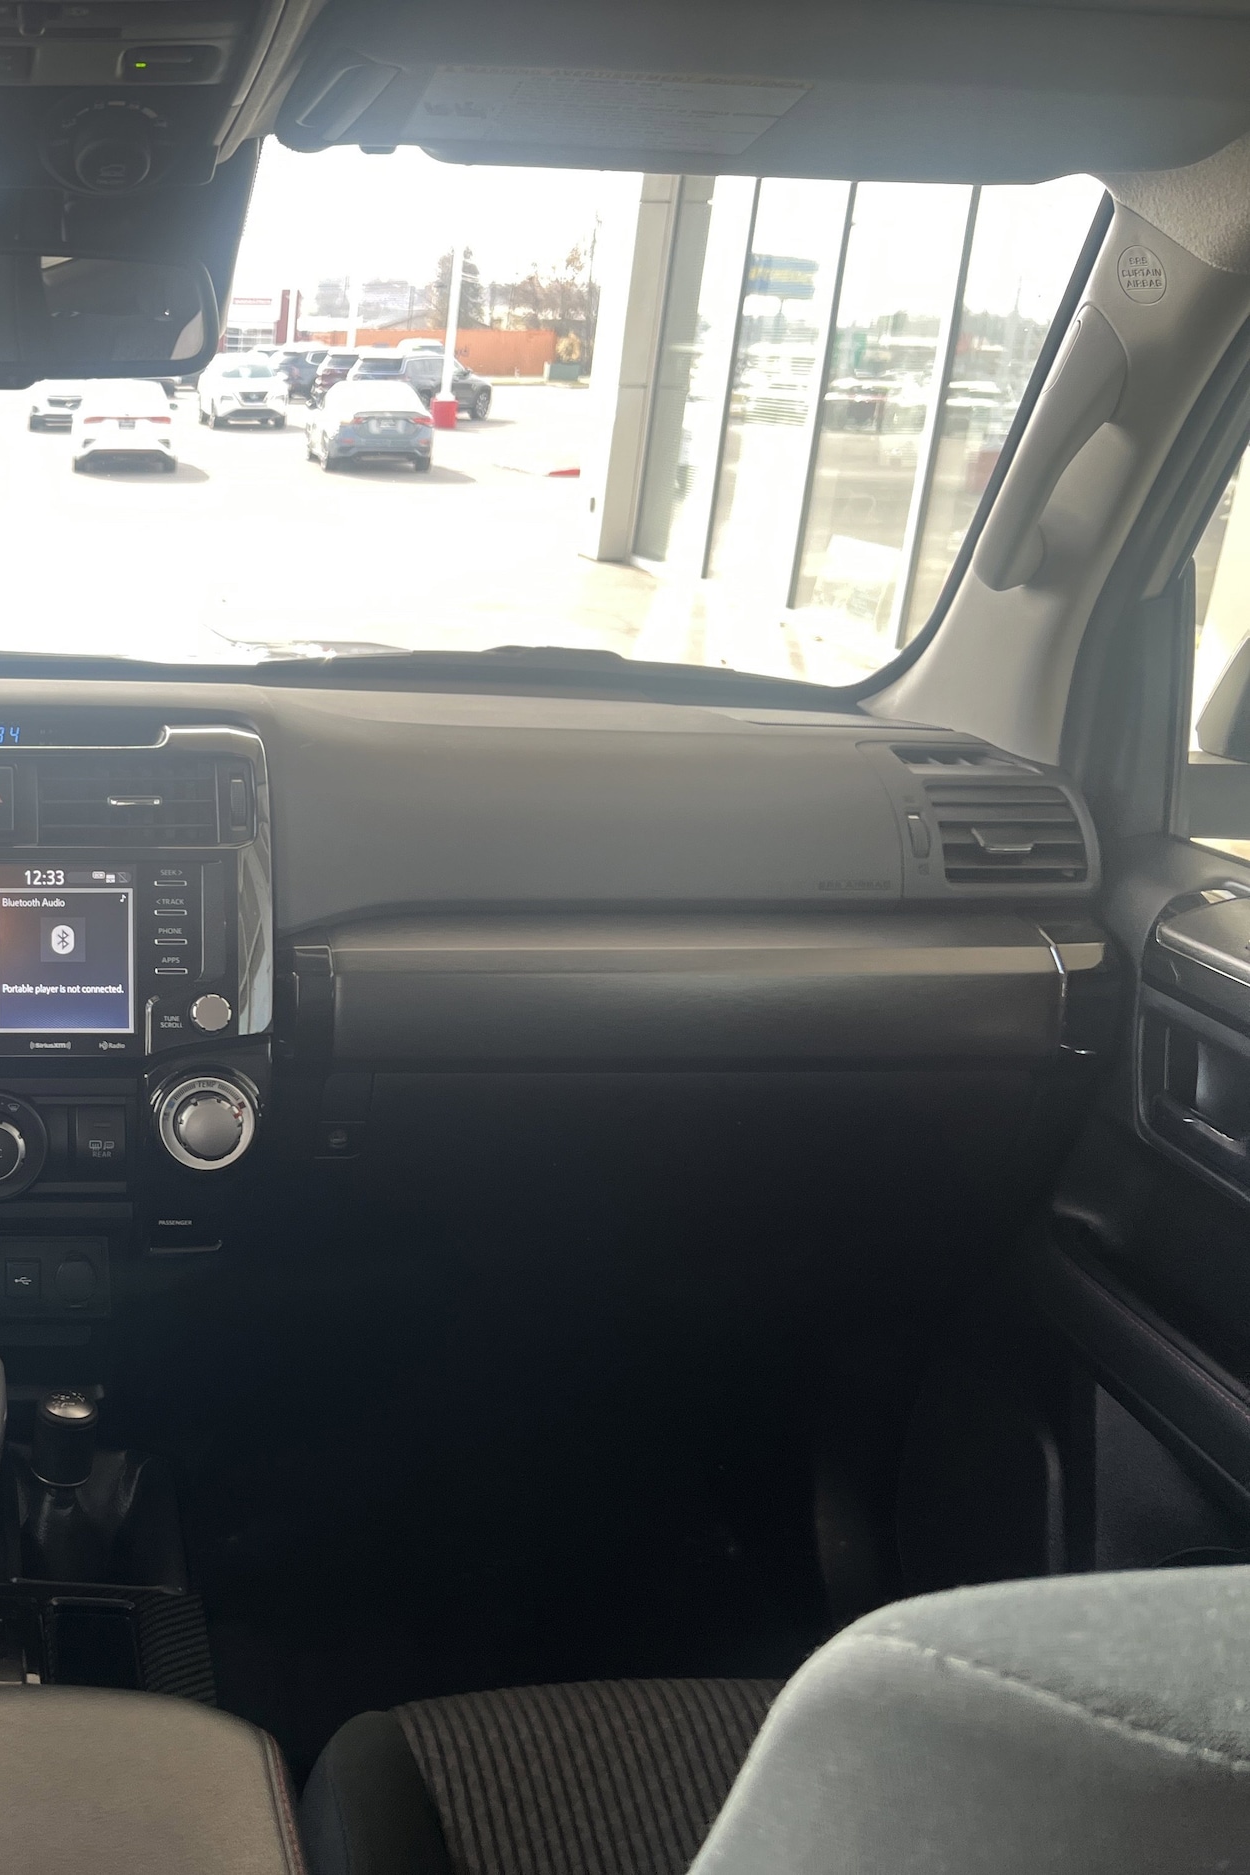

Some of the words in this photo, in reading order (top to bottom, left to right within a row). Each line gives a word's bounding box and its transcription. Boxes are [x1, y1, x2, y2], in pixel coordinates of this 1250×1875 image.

[1122, 269, 1161, 277] CURTAIN
[1127, 279, 1162, 288] AIRBAG
[24, 870, 65, 886] 12:33
[2, 897, 40, 908] Bluetooth
[41, 897, 66, 908] Audio
[2, 983, 34, 994] Portable
[34, 983, 59, 996] player
[59, 984, 67, 994] is
[68, 984, 81, 994] not
[82, 983, 125, 994] connected.
